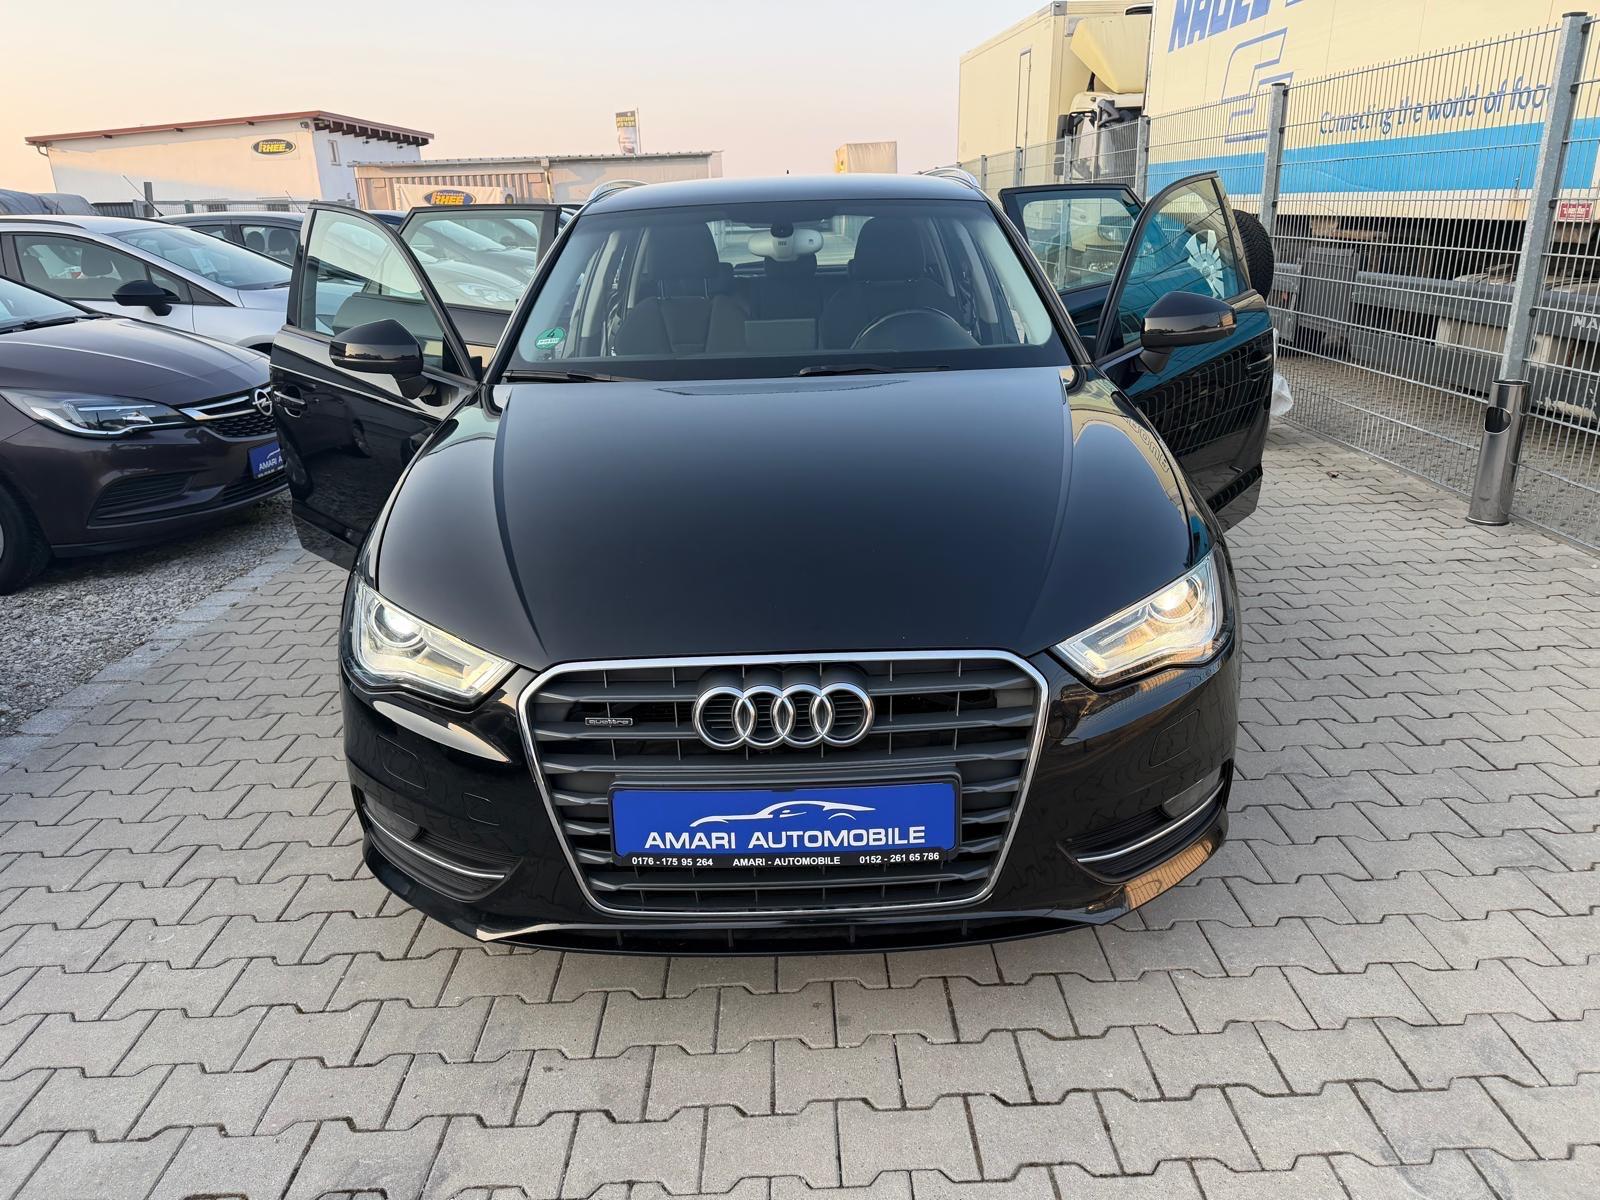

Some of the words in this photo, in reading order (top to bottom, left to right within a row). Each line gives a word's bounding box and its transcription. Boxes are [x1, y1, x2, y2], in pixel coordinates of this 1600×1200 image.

[1319, 103, 1395, 134] Connecting
[1397, 95, 1423, 125] the
[1427, 83, 1480, 120] world
[1484, 79, 1508, 113] of
[1510, 75, 1551, 110] foo
[258, 142, 286, 153] RHEE
[644, 831, 736, 849] AMARI
[748, 826, 926, 849] AUTOMOBILE
[631, 856, 654, 866] 0176
[662, 858, 678, 866] 175
[681, 858, 693, 866] 95
[696, 858, 714, 866] 264
[732, 858, 766, 867] AMARI
[774, 856, 841, 866] AUTOMOBILE
[859, 855, 882, 864] 0152
[890, 854, 906, 863] 261
[909, 853, 921, 862] 65
[923, 852, 940, 861] 786
